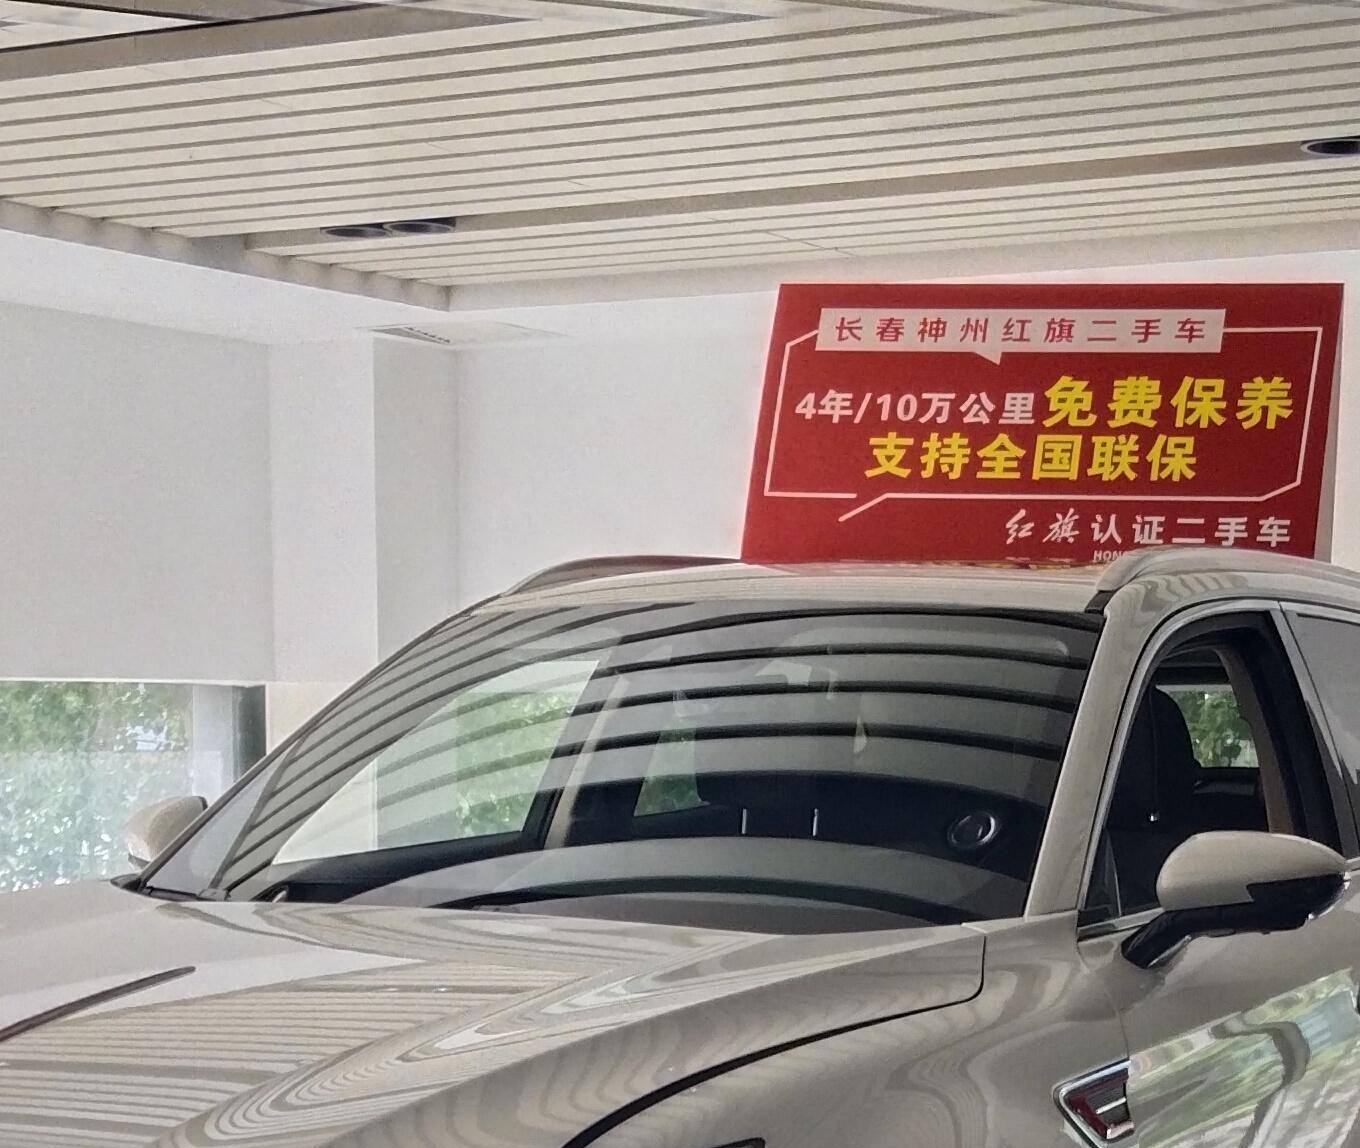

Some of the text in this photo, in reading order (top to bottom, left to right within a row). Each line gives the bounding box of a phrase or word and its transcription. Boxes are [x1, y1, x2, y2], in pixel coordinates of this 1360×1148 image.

[835, 317, 1207, 343] 长春神州红旗二手车
[1042, 376, 1294, 429] 免费保养
[865, 431, 1198, 482] 支持全国联保
[1093, 550, 1127, 562] HON
